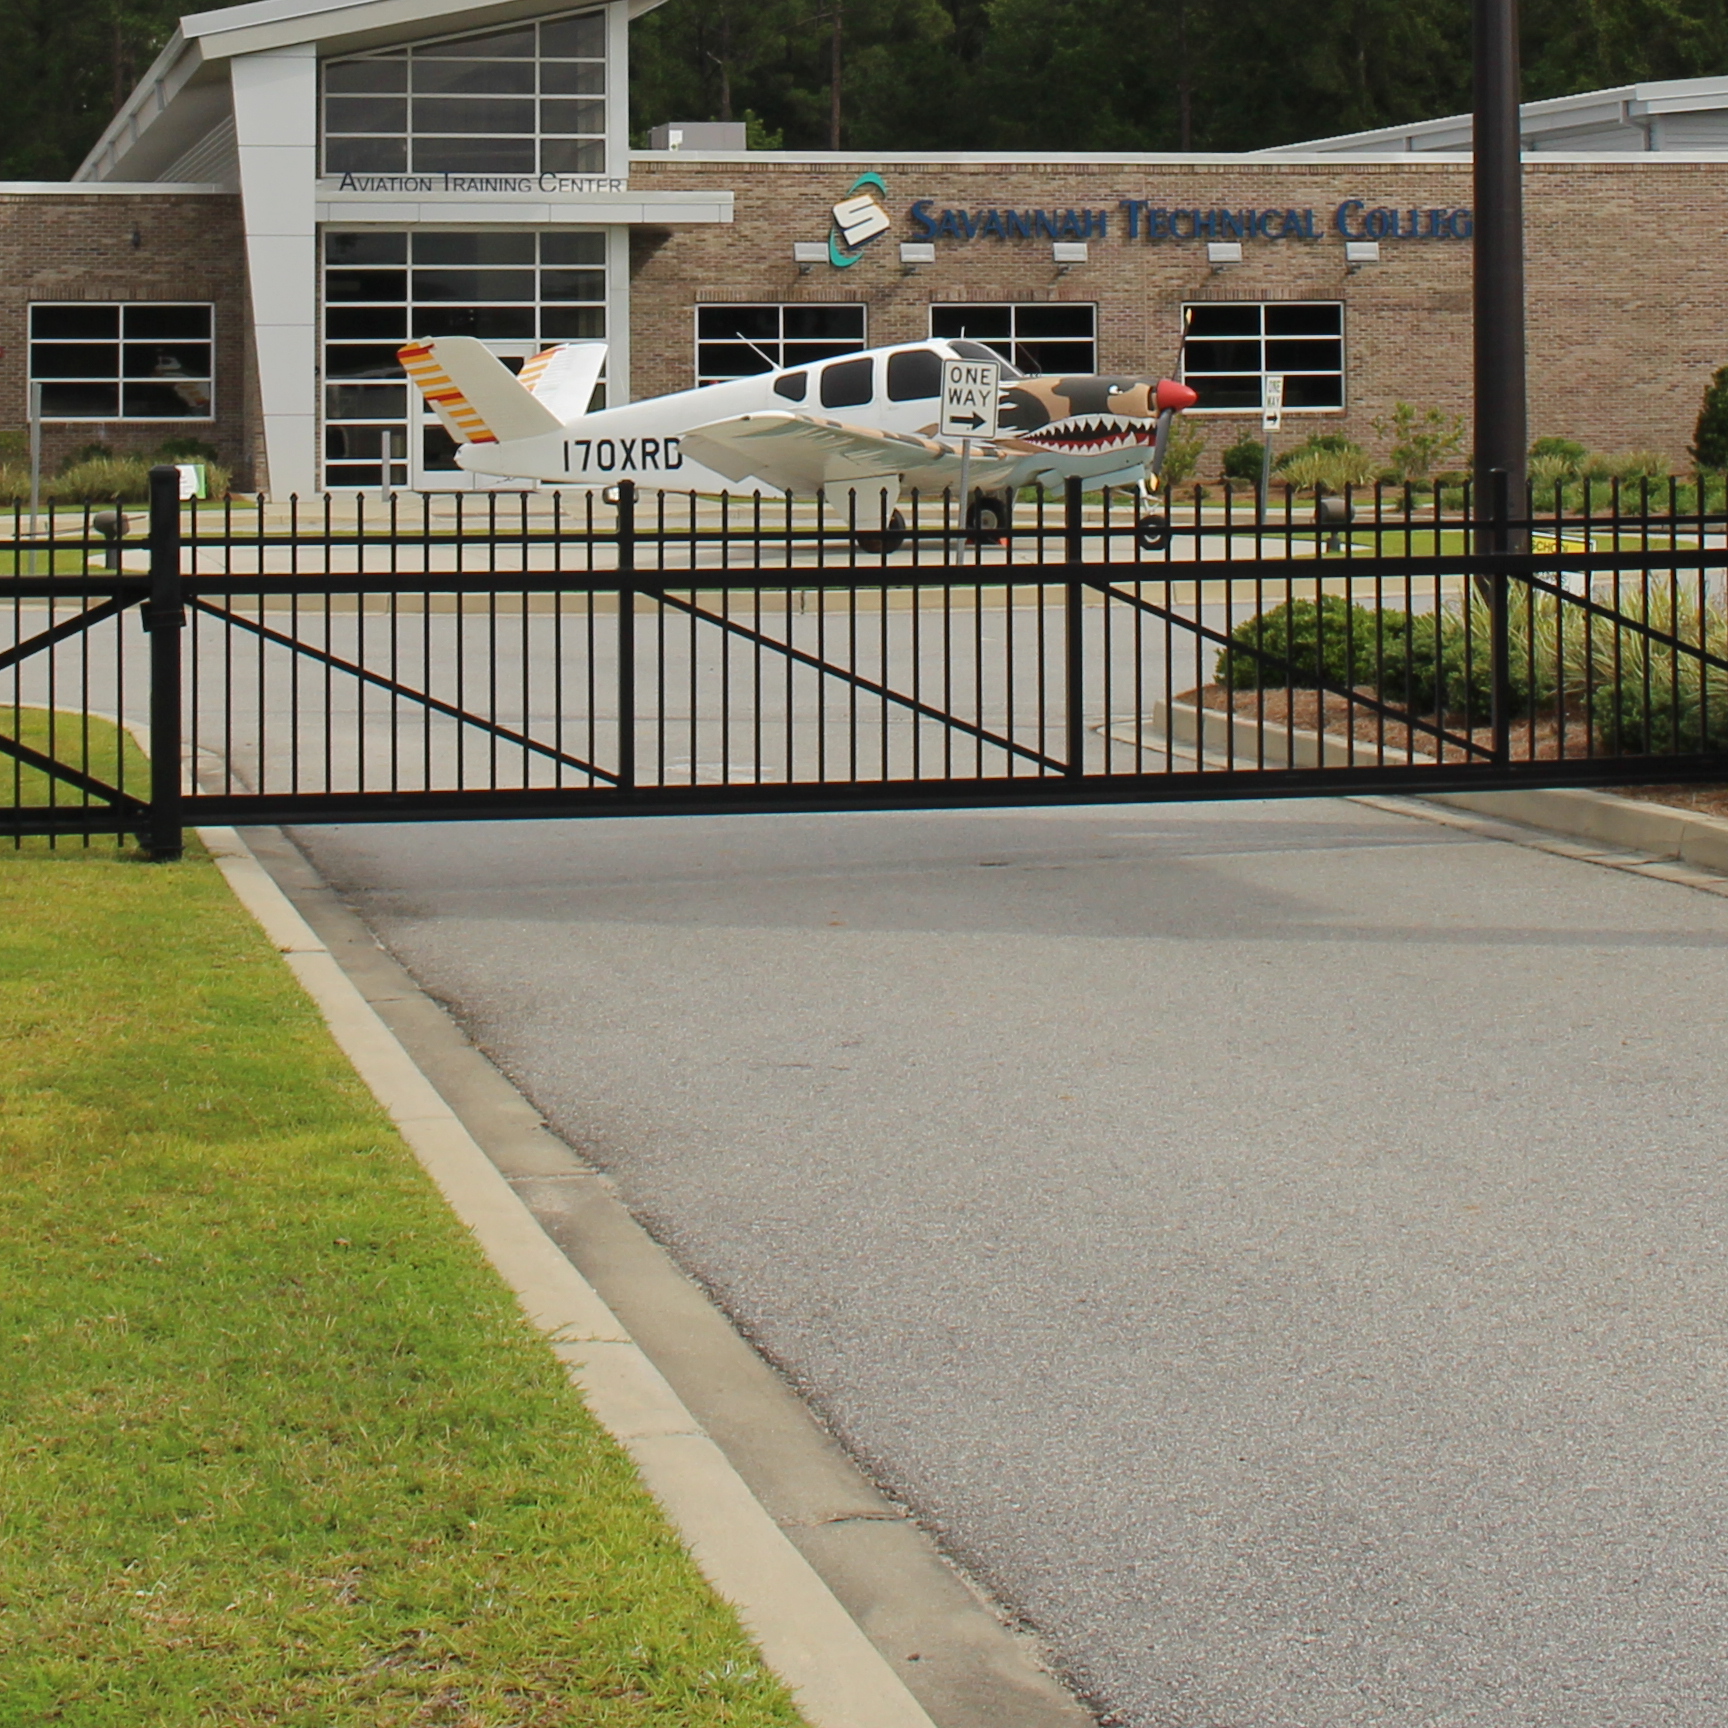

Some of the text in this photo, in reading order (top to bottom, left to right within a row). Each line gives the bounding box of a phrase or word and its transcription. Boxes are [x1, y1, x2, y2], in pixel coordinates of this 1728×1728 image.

[338, 171, 622, 193] AVIATION TRAINING CENTER
[910, 198, 1473, 240] SAVANNAH TECHNICAL COLLEG
[949, 365, 992, 386] ONE
[947, 386, 992, 408] WAY
